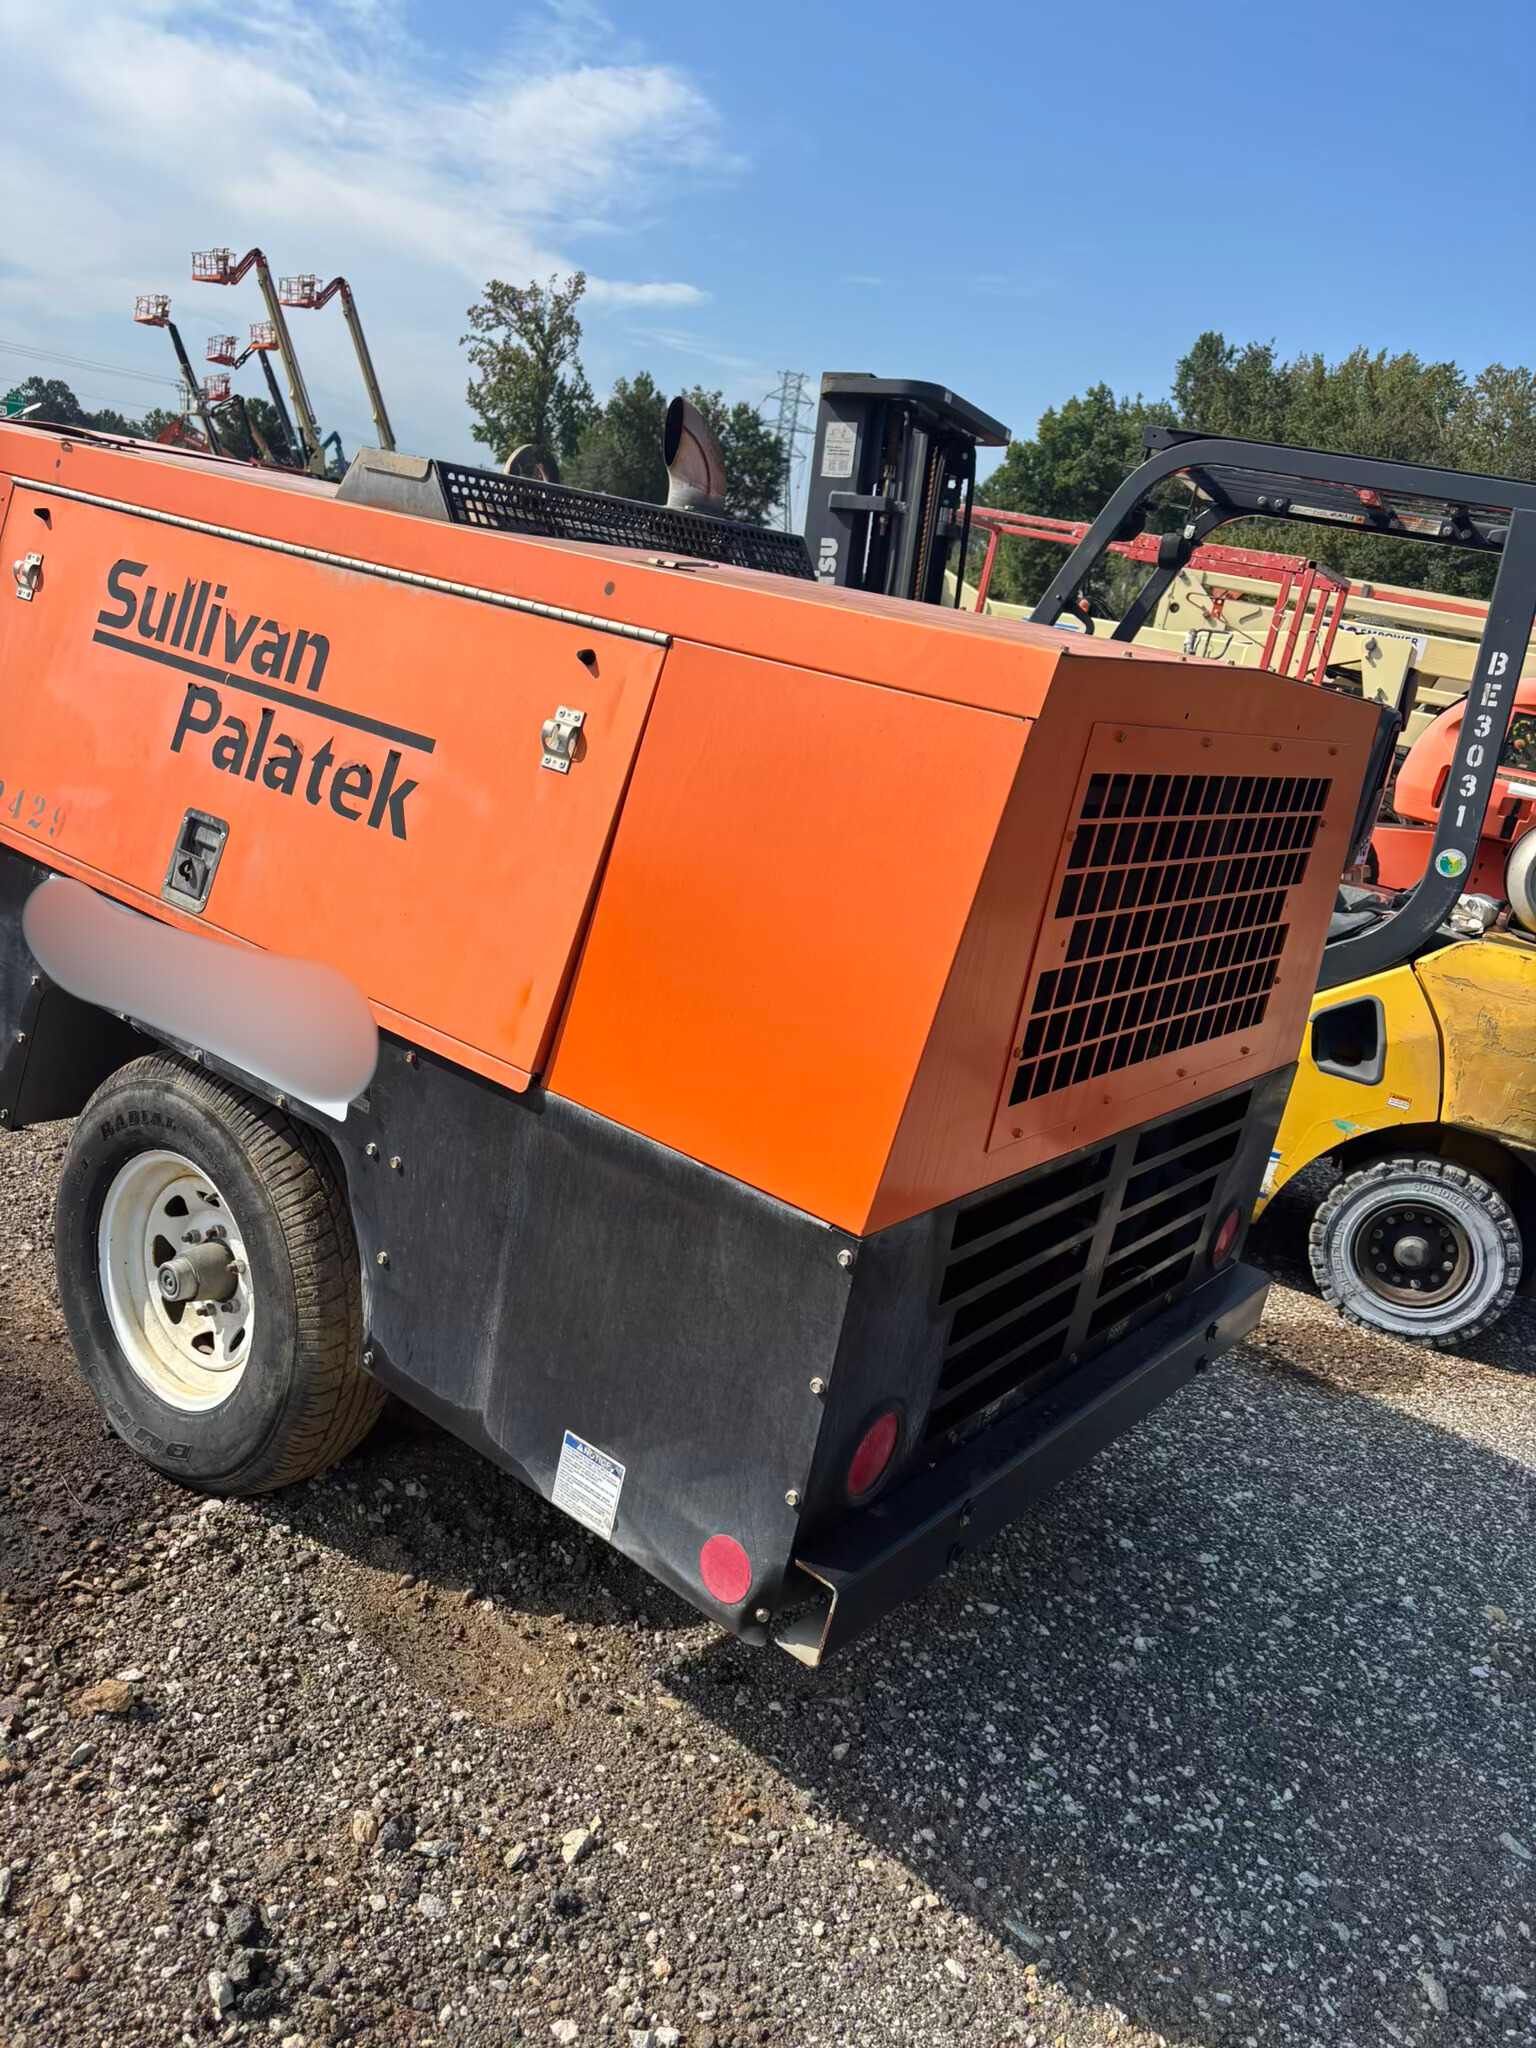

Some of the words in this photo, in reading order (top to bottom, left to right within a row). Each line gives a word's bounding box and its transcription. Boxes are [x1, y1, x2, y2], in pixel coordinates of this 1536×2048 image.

[97, 558, 331, 692] Sullivan
[170, 683, 420, 840] Palatek
[1455, 651, 1509, 828] BE3031
[1412, 1182, 1472, 1214] SOLIDEAL
